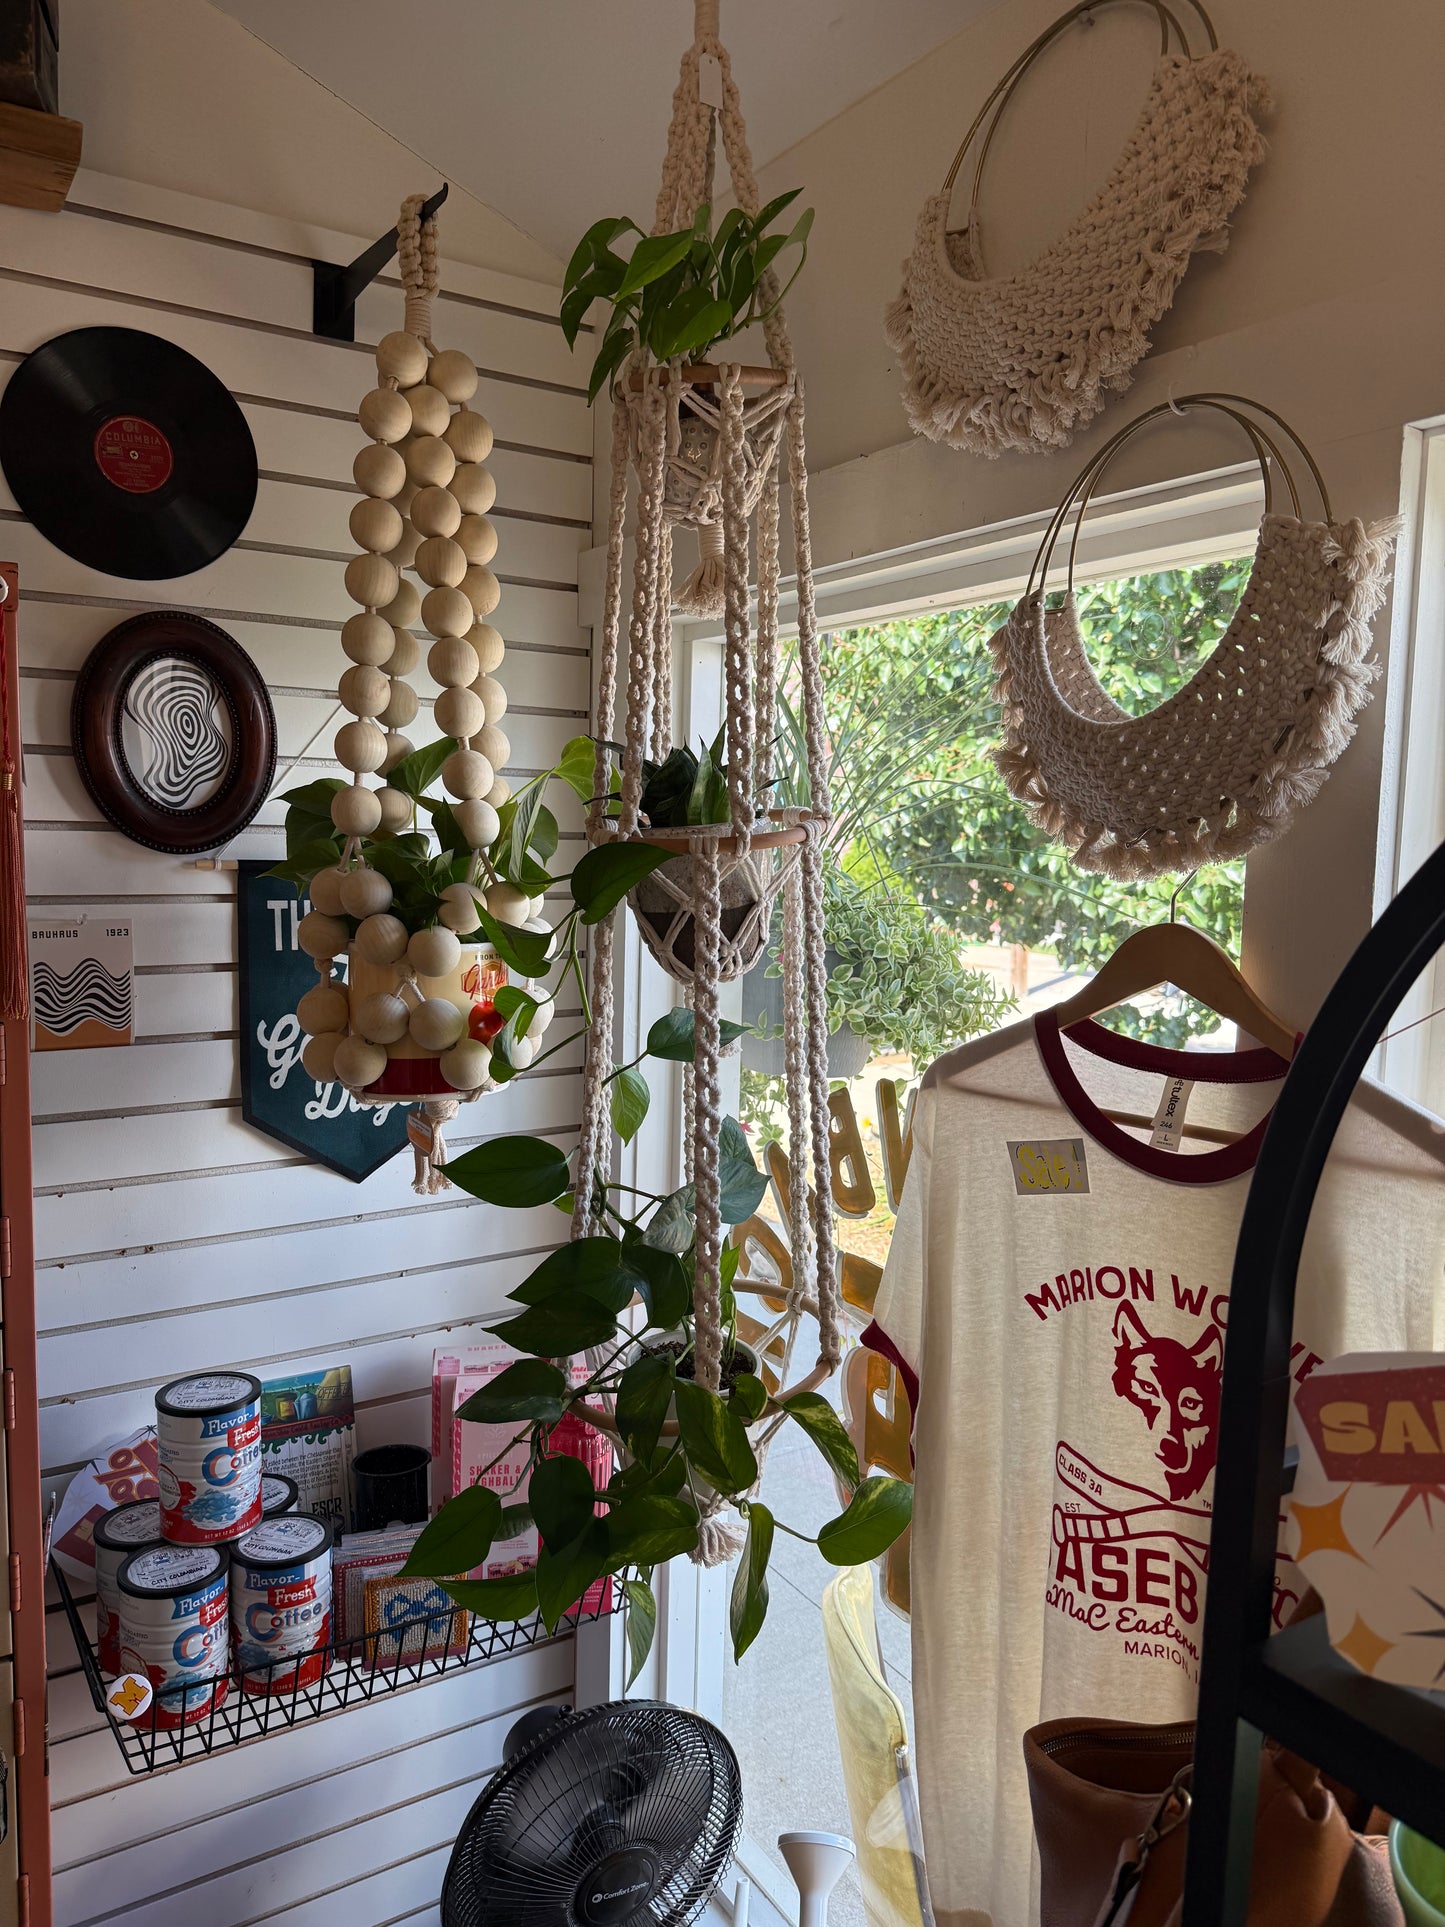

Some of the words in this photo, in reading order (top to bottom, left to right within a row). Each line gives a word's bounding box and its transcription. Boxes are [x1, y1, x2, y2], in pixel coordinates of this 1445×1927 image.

[105, 431, 161, 446] COLUMBIA
[32, 930, 78, 939] BAUHAUS
[106, 928, 129, 937] 1923
[1165, 1086, 1182, 1117] tultex
[1160, 1120, 1173, 1129] 246
[1024, 1266, 1155, 1321] MARION
[1319, 1401, 1445, 1455] SA
[202, 1444, 261, 1488] Coffe
[469, 1464, 510, 1476] SHKER
[515, 1464, 521, 1475] &
[1058, 1453, 1087, 1484] CLASS
[1088, 1479, 1103, 1496] 3A
[469, 1475, 519, 1487] HGHBAL
[1064, 1502, 1081, 1513] EST
[151, 1576, 167, 1586] CITY
[168, 1565, 208, 1579] COLOMBIAN
[249, 1574, 301, 1588] Flavor-
[1048, 1540, 1200, 1625] ASEB
[179, 1586, 224, 1616] Flavor-
[274, 1584, 313, 1606] Fresh
[245, 1602, 322, 1644] Coffee
[1045, 1583, 1110, 1631] aMaC
[1115, 1607, 1200, 1661] Eastern
[172, 1616, 229, 1668] Coffe
[603, 1887, 630, 1900] Comfort
[630, 1881, 647, 1892] Zone
